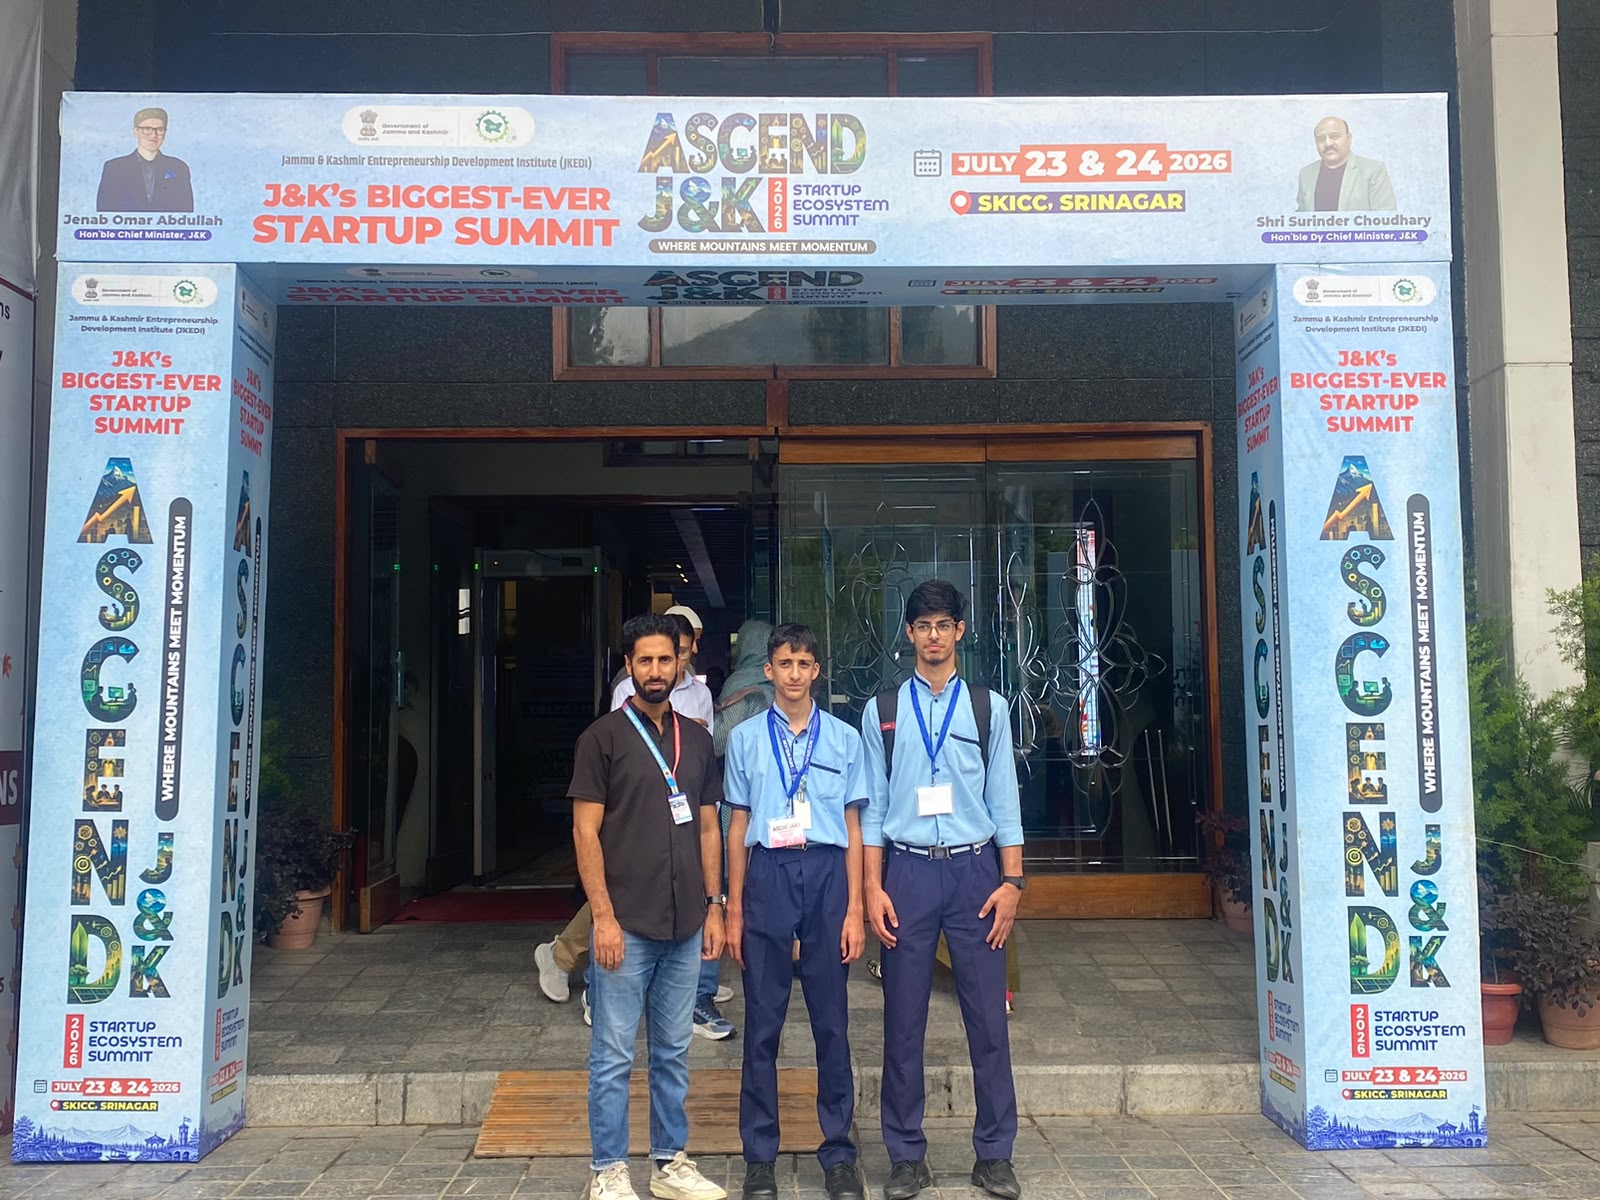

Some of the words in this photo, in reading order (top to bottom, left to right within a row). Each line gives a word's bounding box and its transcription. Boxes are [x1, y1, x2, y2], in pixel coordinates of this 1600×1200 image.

[638, 112, 867, 174] ASCEND
[282, 155, 315, 167] Jammu
[317, 156, 324, 166] &
[326, 155, 366, 166] Kashmir
[368, 156, 450, 169] Entrepreneurship
[452, 156, 514, 169] Development
[517, 157, 557, 168] Institute
[559, 156, 592, 169] (JKEDI)
[957, 155, 1017, 173] JULY
[1025, 150, 1067, 176] 23
[1079, 150, 1105, 176] &
[1115, 149, 1163, 176] 24
[1169, 153, 1227, 171] 2026
[367, 184, 611, 211] BIGGEST-EVER
[793, 184, 861, 196] STARTUP
[637, 176, 766, 233] J&K
[773, 181, 783, 229] 2026
[793, 199, 889, 211] ECOSYSTEM
[978, 194, 1053, 212] SKICC,
[1059, 193, 1184, 211] SRINAGAR
[64, 214, 108, 225] Jenab
[113, 215, 152, 226] Omar
[157, 215, 223, 226] Abdullah
[793, 214, 859, 226] SUMMIT
[1257, 215, 1285, 227] Shri
[1289, 215, 1349, 227] Surinder
[1353, 215, 1431, 228] Choudhary
[118, 231, 143, 239] Chief
[145, 231, 186, 240] Minister,
[188, 231, 207, 239] J&K
[252, 214, 442, 244] STARTUP
[454, 217, 620, 246] SUMMIT
[1311, 233, 1323, 243] Dy
[1326, 233, 1351, 241] Chief
[1399, 232, 1418, 240] J&K
[658, 242, 697, 251] WHERE
[700, 242, 766, 251] MOUNTAINS
[769, 242, 797, 251] MEET
[800, 242, 868, 252] MOMENTUM
[642, 271, 864, 286] ASCEND
[647, 286, 764, 300] J&K
[110, 315, 144, 323] Kashmir
[146, 316, 218, 325] Entrepreneurship
[1369, 315, 1439, 324] Entrepreneurship
[81, 325, 136, 334] Development
[1305, 326, 1360, 334] Development
[1362, 325, 1396, 333] Institute
[62, 372, 221, 391] BIGGEST-EVER
[1291, 372, 1447, 389] BIGGEST-EVER
[89, 395, 191, 412] STARTUP
[1319, 394, 1419, 411] STARTUP
[95, 417, 184, 435] SUMMIT
[1245, 404, 1271, 433] STARTUP
[1327, 416, 1414, 432] SUMMIT
[171, 515, 186, 605] MOMENTUM
[1413, 511, 1428, 600] MOMENTUM
[169, 607, 182, 649] MEET
[1417, 602, 1430, 643] MEET
[163, 652, 181, 741] MOUNTAINS
[1418, 645, 1434, 735] MOUNTAINS
[67, 457, 154, 1004] ASCEND
[1319, 455, 1401, 994] ASCEND
[1425, 736, 1437, 794] WHERE
[161, 745, 176, 802] WHERE
[1374, 1011, 1439, 1022] STARTUP
[89, 1021, 156, 1032] STARTUP
[1356, 1008, 1366, 1054] 2026
[1375, 1026, 1465, 1036] ECOSYSTEM
[69, 1018, 80, 1065] 2026
[89, 1036, 182, 1047] ECOSYSTEM
[1375, 1040, 1438, 1051] SUMMIT
[88, 1051, 153, 1062] SUMMIT
[1345, 1072, 1372, 1081] JULY
[1375, 1069, 1394, 1083] 23
[1399, 1070, 1411, 1083] &
[1415, 1069, 1437, 1083] 24
[1439, 1072, 1465, 1080] 2026
[54, 1082, 83, 1092] JULY
[85, 1080, 105, 1094] 23
[110, 1081, 122, 1094] &
[127, 1081, 149, 1094] 24
[152, 1083, 179, 1092] 2026
[1391, 1090, 1446, 1098] SRINAGAR
[100, 1102, 157, 1110] SRINAGAR
